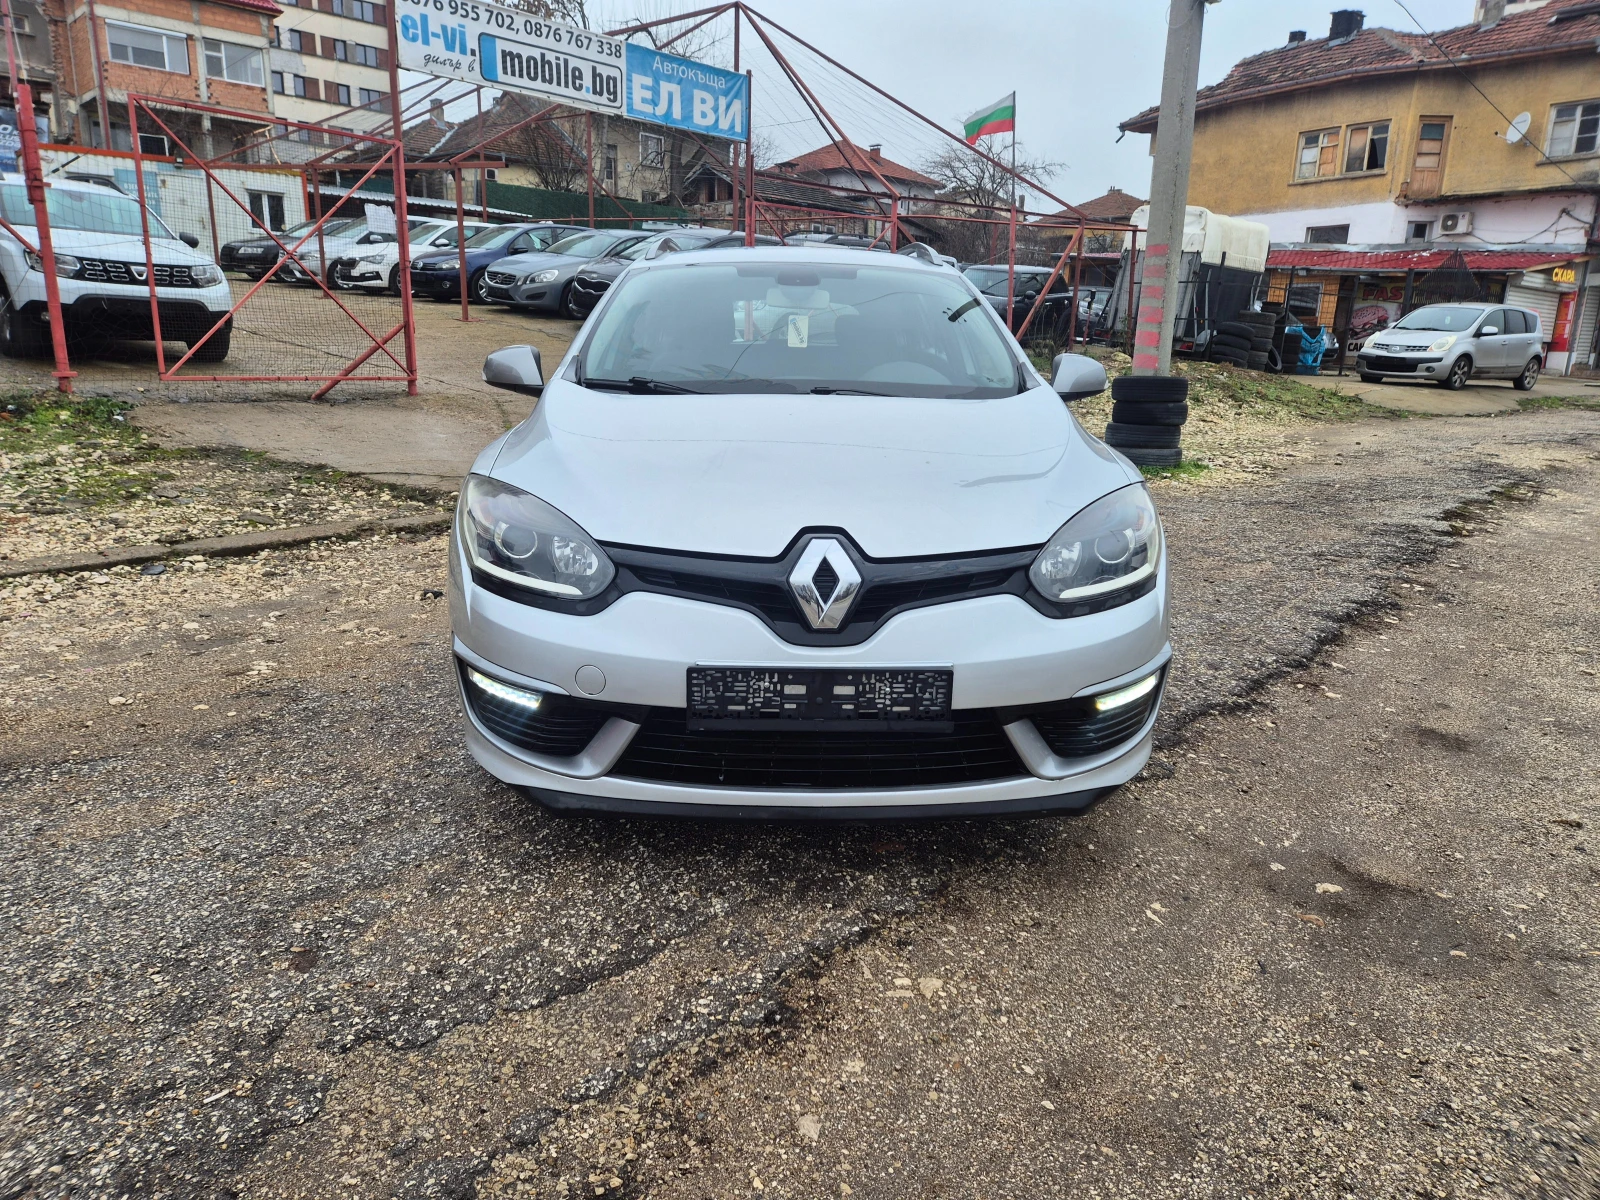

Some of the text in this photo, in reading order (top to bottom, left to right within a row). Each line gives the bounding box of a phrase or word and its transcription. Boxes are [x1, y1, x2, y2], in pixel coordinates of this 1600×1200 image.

[449, 0, 480, 22] 955
[485, 8, 520, 35] 702,
[524, 19, 562, 43] 0876
[566, 30, 592, 51] 767
[597, 39, 622, 59] 338
[501, 48, 618, 103] mobile.bg
[653, 55, 726, 90] Автокъща
[632, 72, 742, 133] ЕЛ ВИ
[1362, 286, 1406, 301] FAS
[1552, 267, 1576, 283] СКАРА
